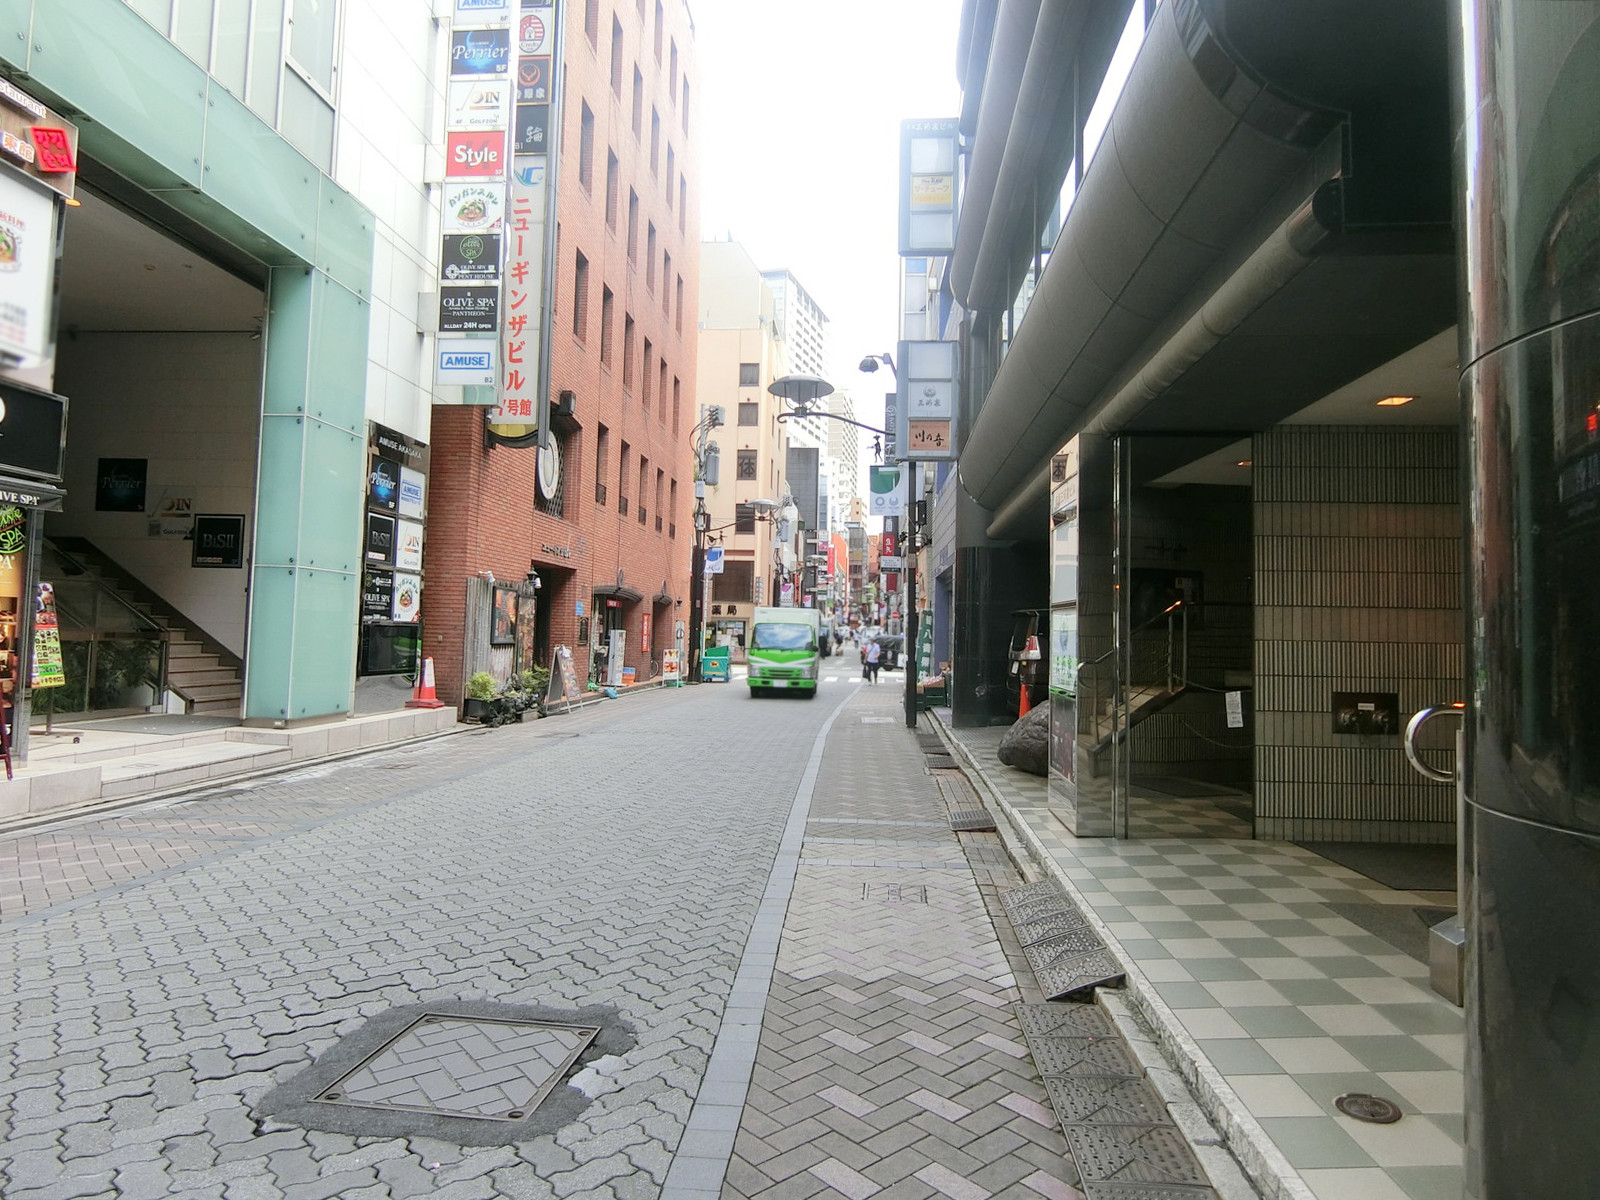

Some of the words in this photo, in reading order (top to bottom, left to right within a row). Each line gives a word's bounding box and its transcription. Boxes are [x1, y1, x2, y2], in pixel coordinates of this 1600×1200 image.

[453, 44, 508, 60] Perrier
[454, 144, 498, 167] Style
[506, 198, 531, 391] ニューギンザビル
[443, 297, 475, 307] OLIVE
[476, 297, 494, 307] SPA
[463, 321, 478, 329] 24H
[445, 356, 486, 366] AMUSE
[19, 493, 39, 506] SPA
[711, 604, 737, 616] 薬局
